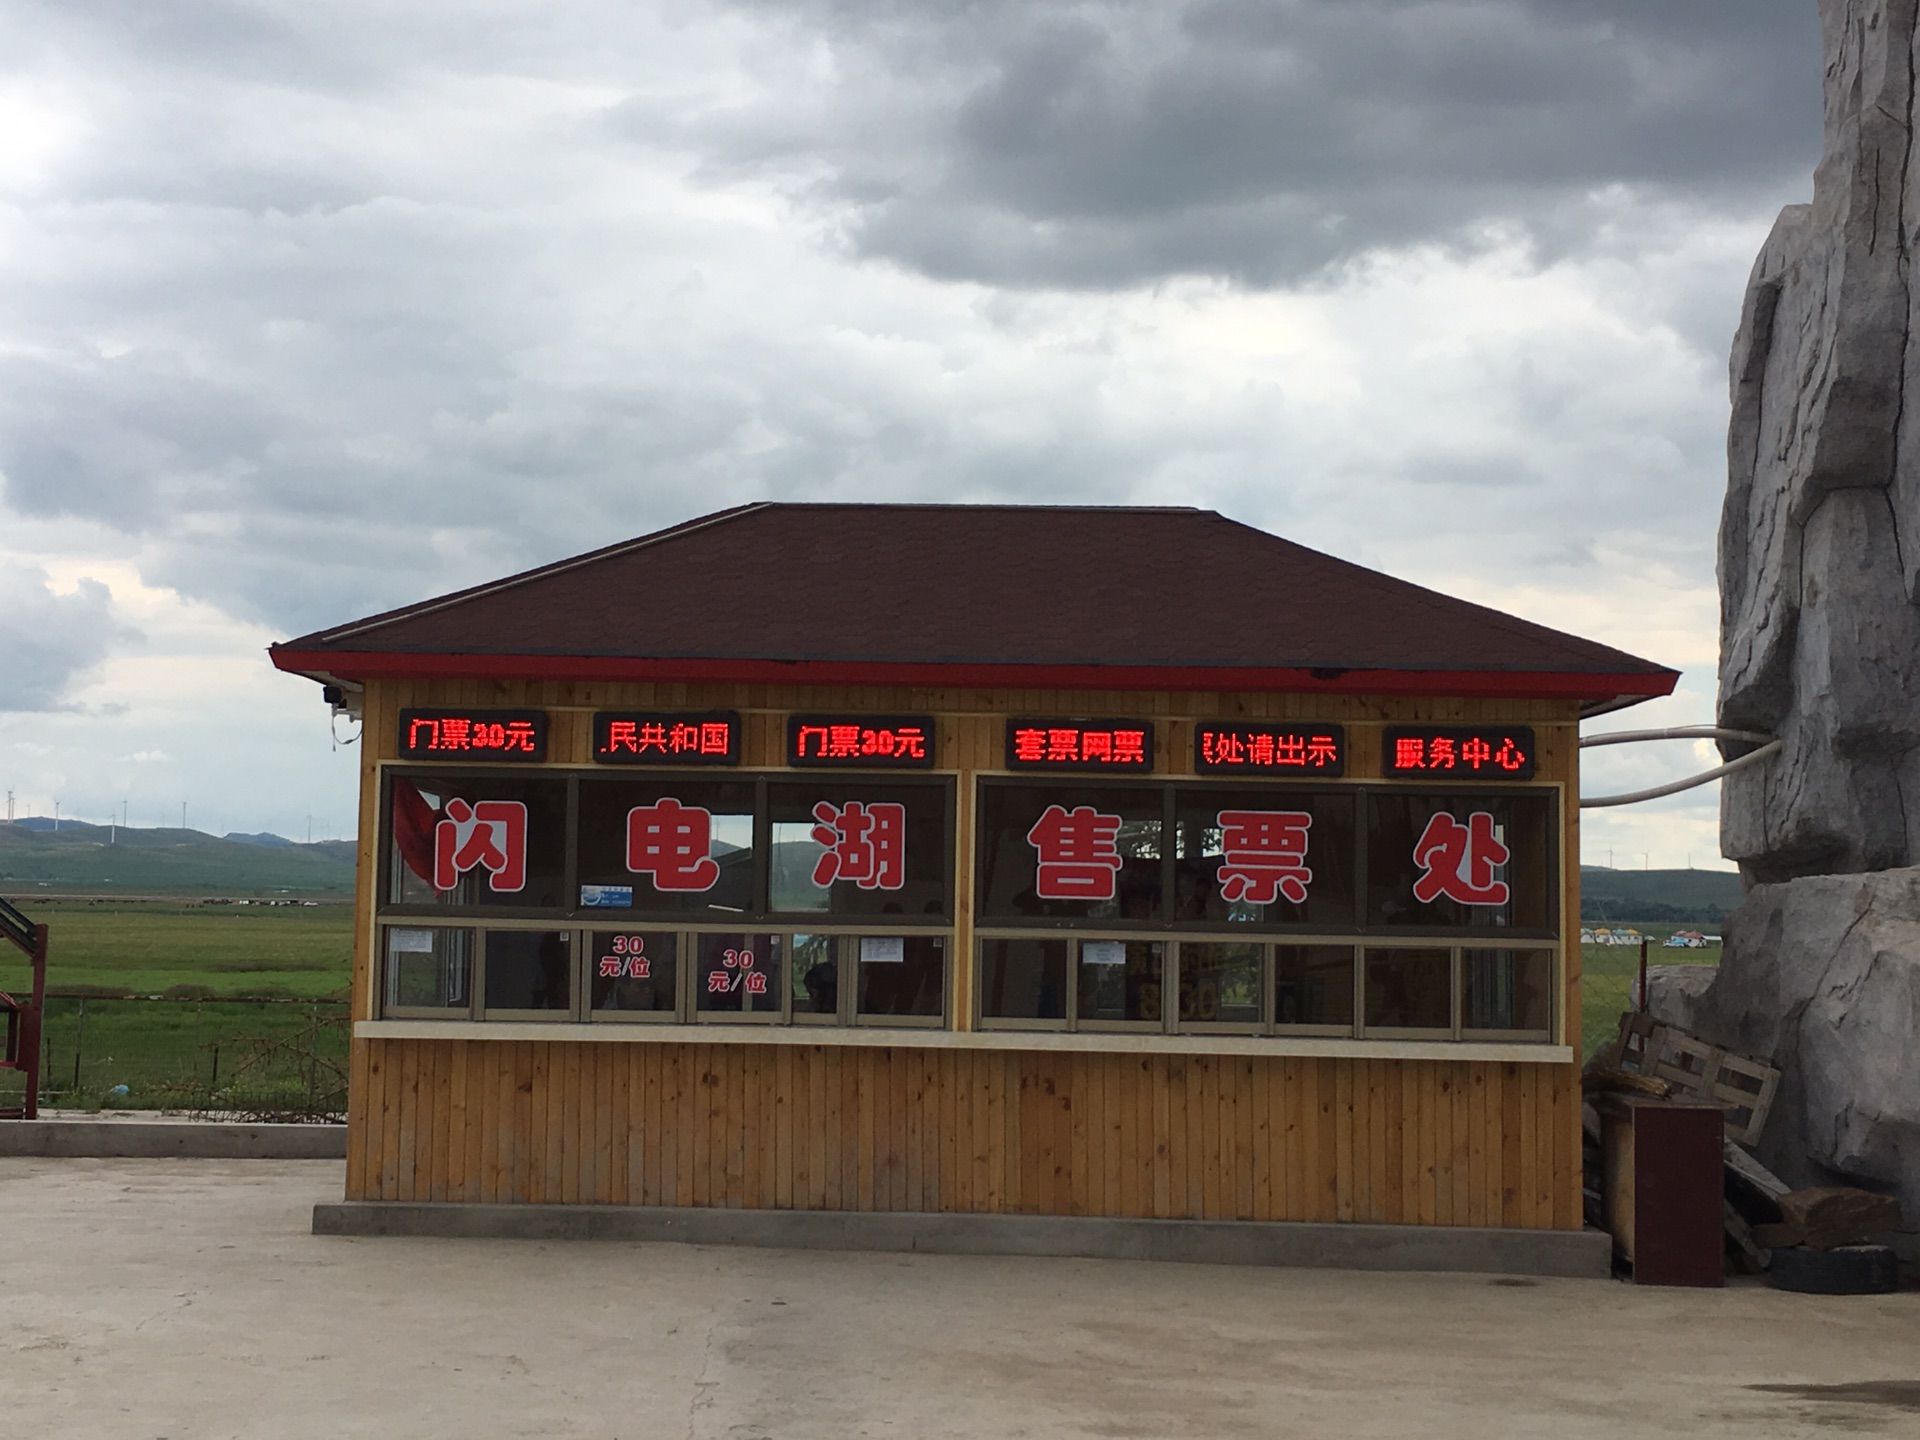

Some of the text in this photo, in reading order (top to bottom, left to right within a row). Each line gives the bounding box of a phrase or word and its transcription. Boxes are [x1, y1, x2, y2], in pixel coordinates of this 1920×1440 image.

[409, 719, 535, 751] 门票30元
[601, 721, 729, 755] 民共和国
[799, 725, 925, 758] 门票30元
[1015, 728, 1145, 762] 套票网票
[1395, 737, 1526, 769] 服务中心
[613, 936, 644, 954] 30
[723, 949, 754, 968] 30
[600, 956, 650, 978] 元/位
[708, 971, 767, 993] 元/位
